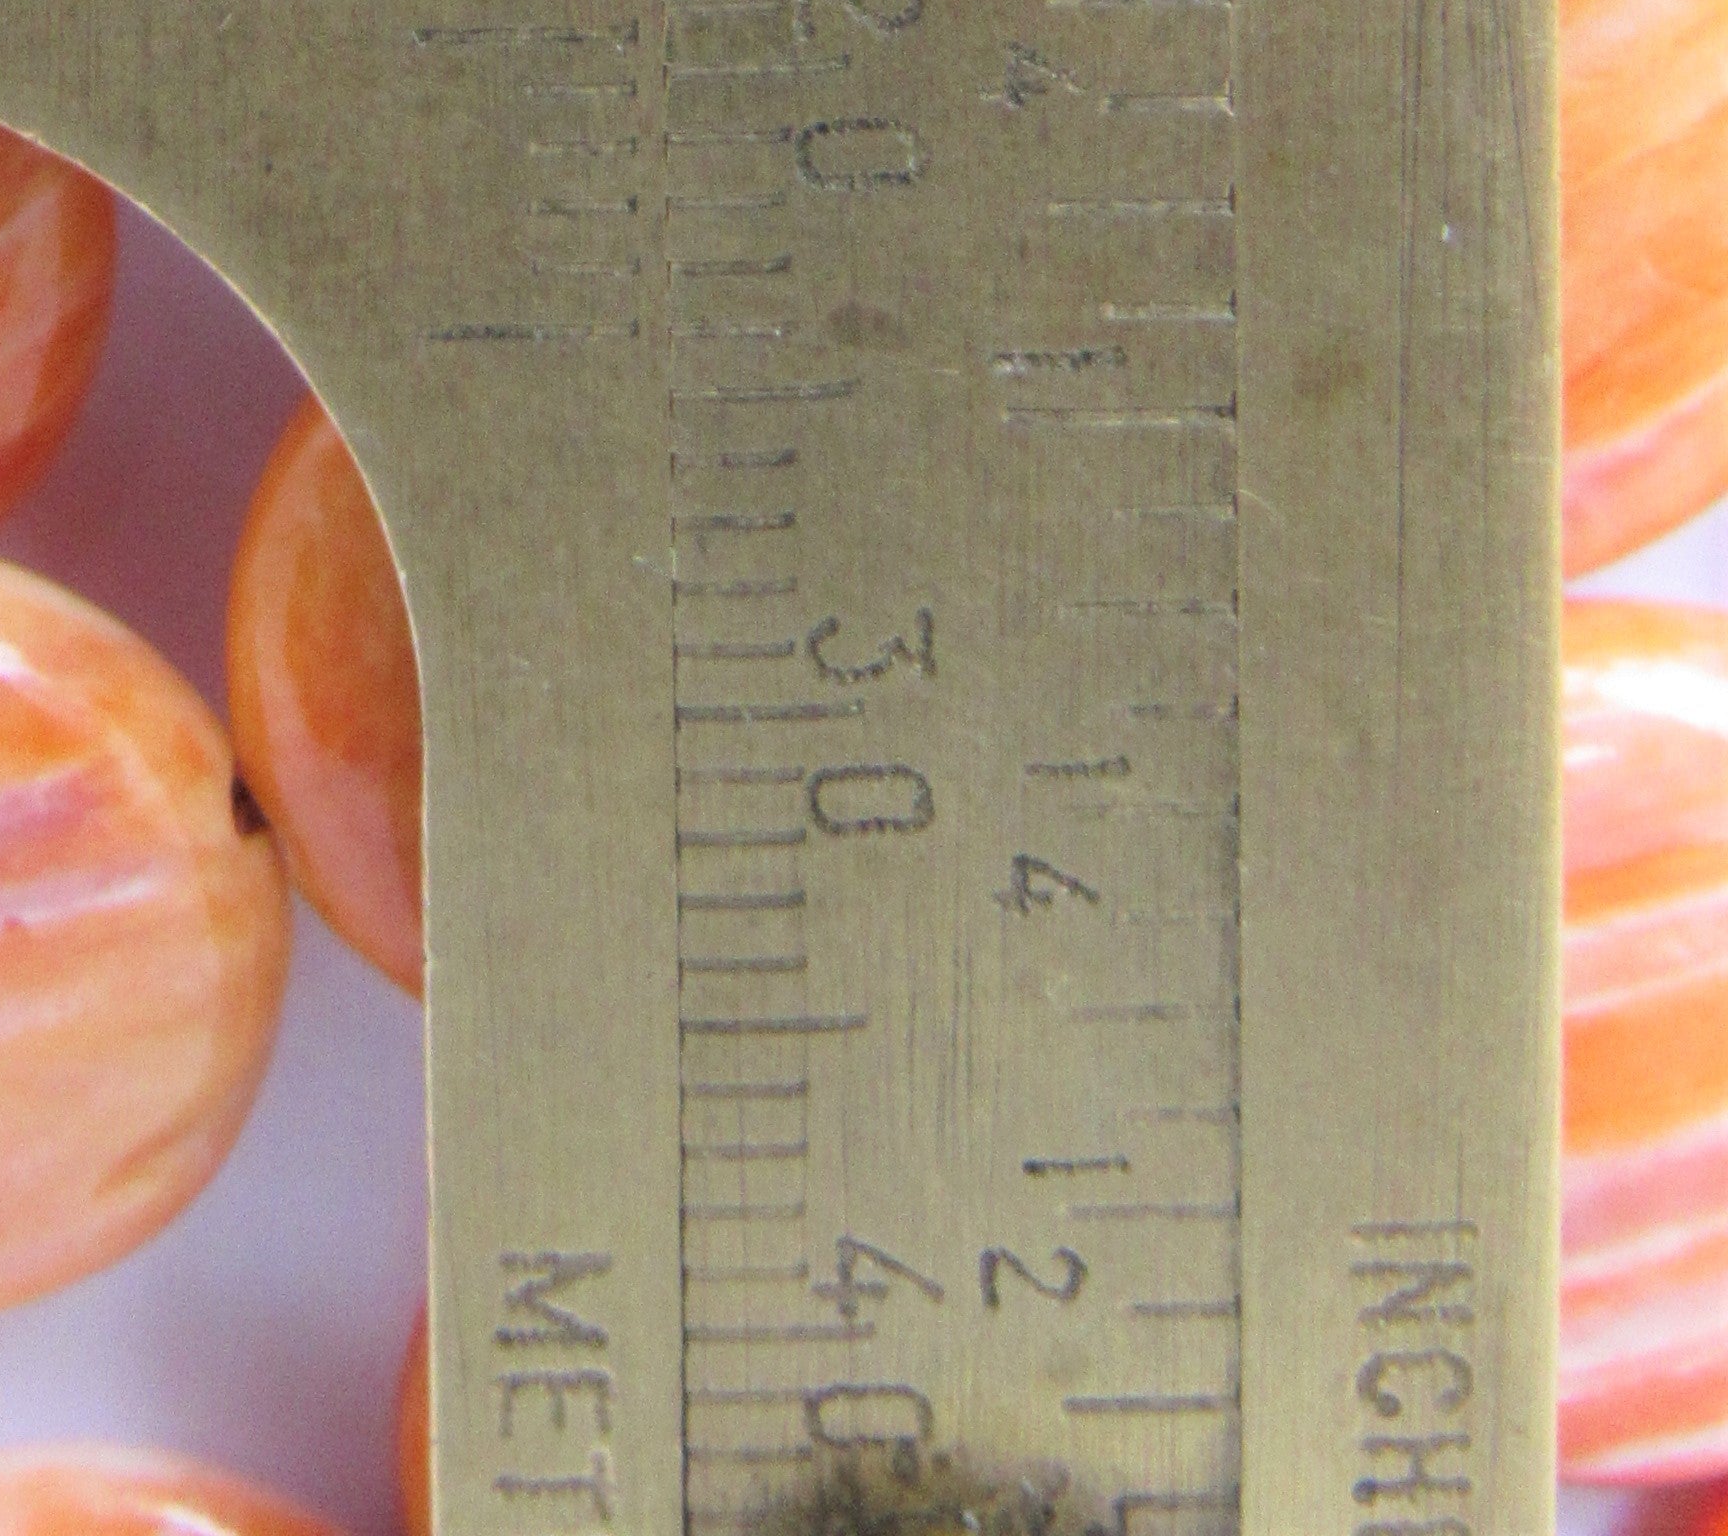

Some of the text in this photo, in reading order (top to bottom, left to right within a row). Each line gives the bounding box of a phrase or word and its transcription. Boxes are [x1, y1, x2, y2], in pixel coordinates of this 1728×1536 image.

[806, 605, 937, 834] 30
[492, 1250, 613, 1522] MET
[804, 1233, 945, 1448] 40
